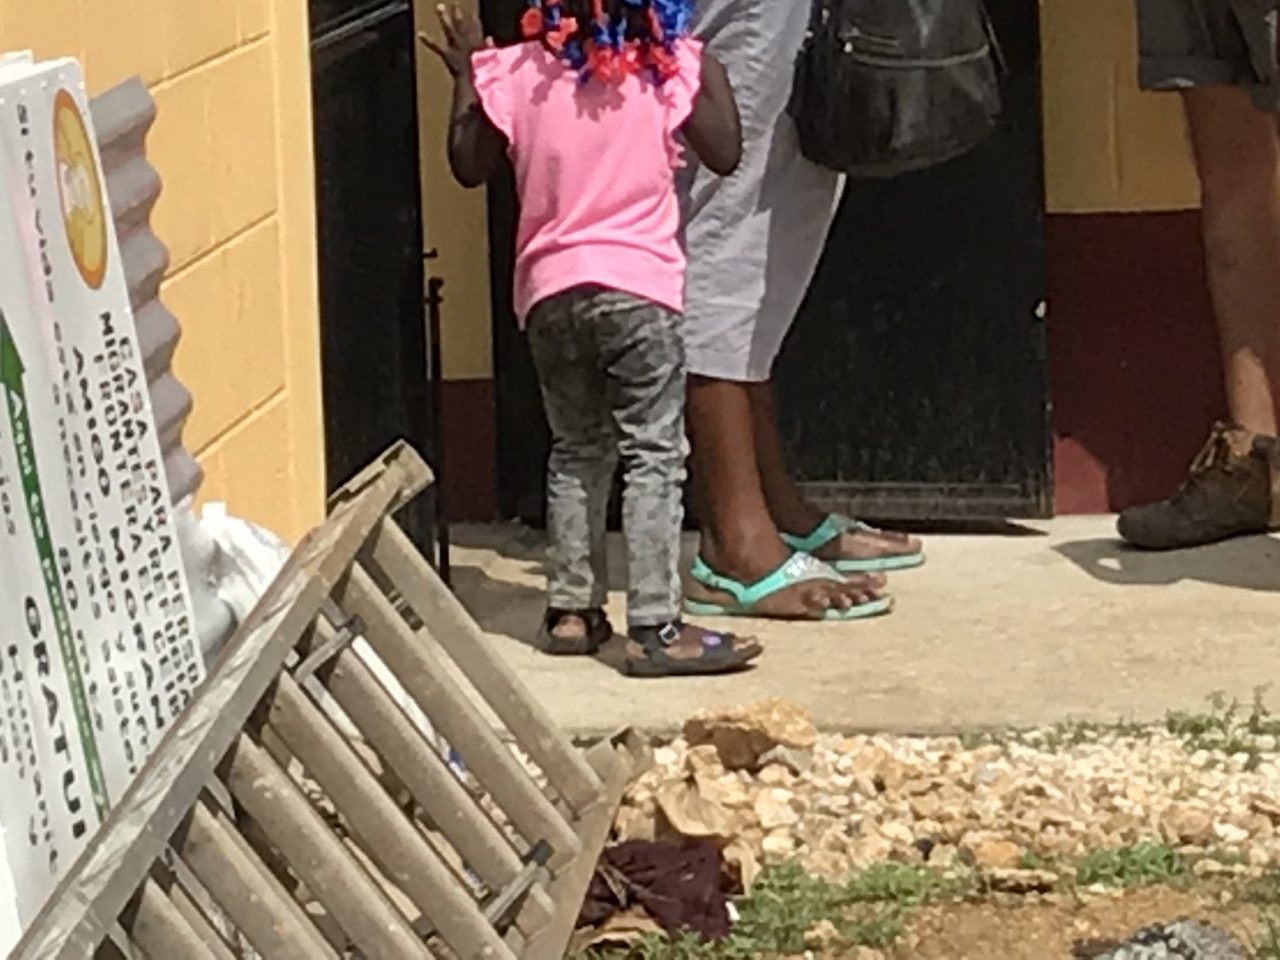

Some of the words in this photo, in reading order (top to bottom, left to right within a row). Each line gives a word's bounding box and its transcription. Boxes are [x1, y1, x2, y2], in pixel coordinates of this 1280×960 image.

[71, 345, 111, 499] AMIGO
[108, 524, 167, 731] MIGRAN
[92, 353, 144, 554] FRONTERA
[136, 564, 155, 613] EL
[98, 310, 148, 506] MIGRANTES
[141, 515, 157, 534] Y
[118, 335, 149, 441] CASA
[143, 458, 173, 555] PARA
[23, 594, 88, 841] GRATUI
